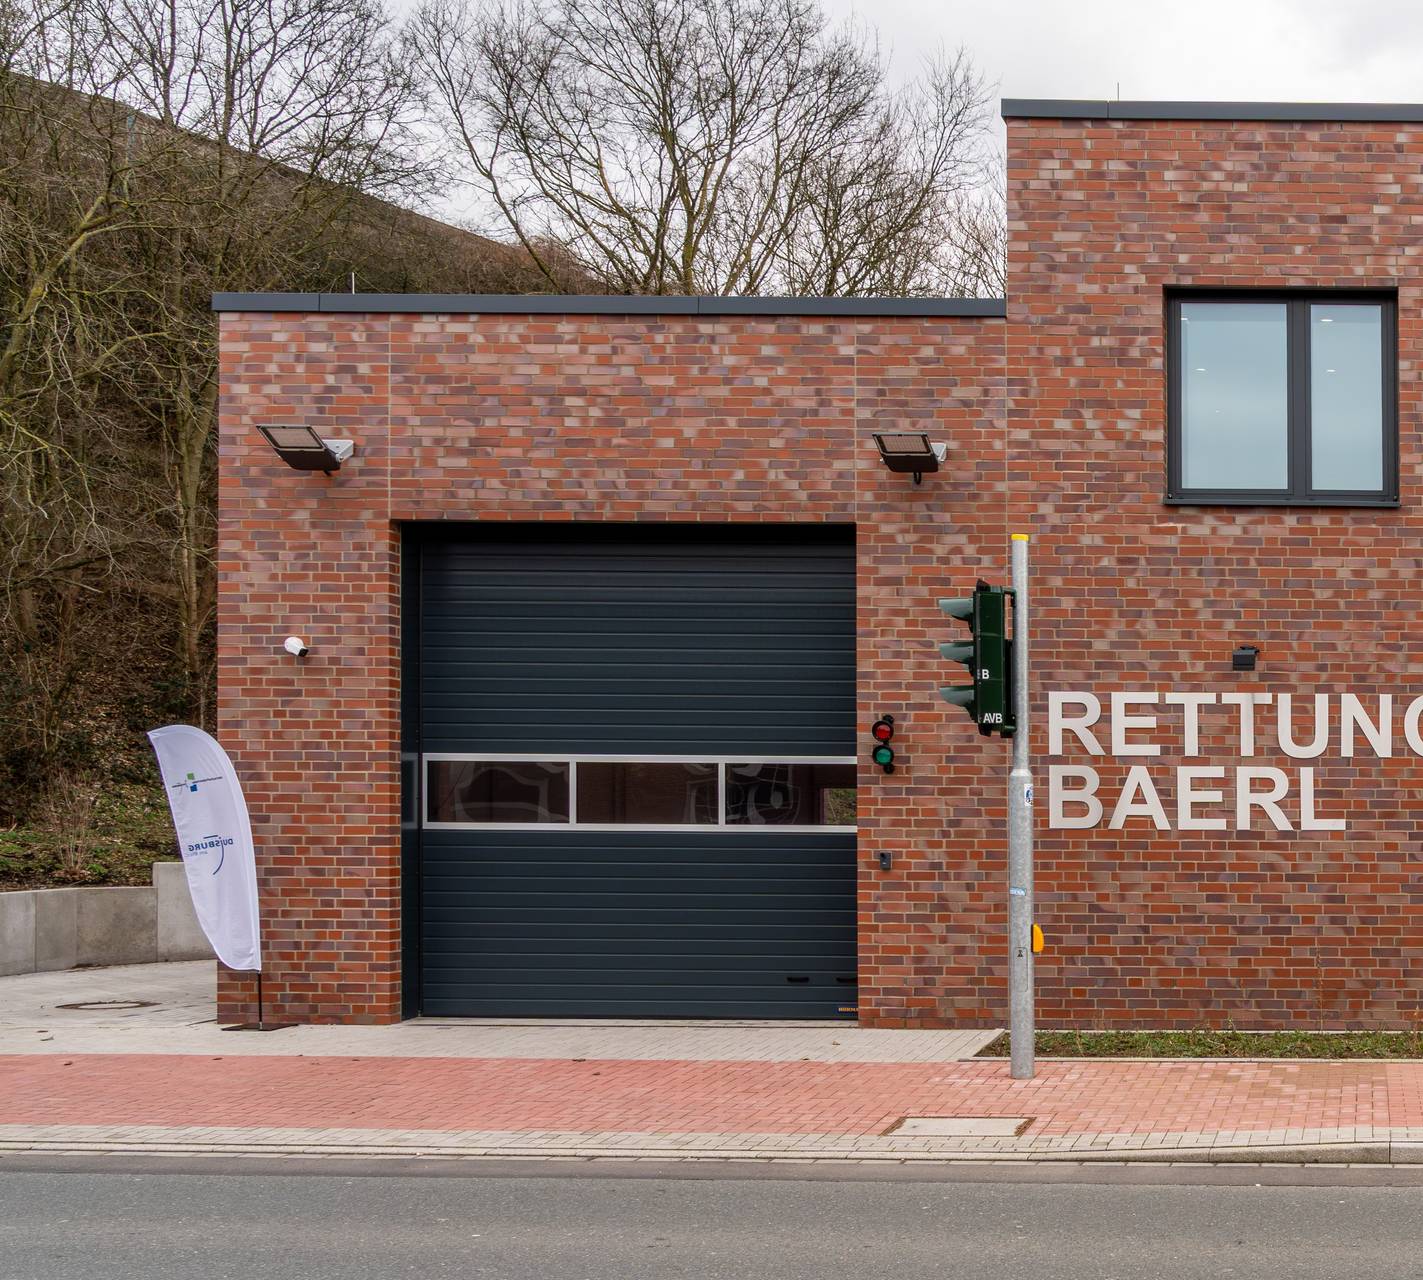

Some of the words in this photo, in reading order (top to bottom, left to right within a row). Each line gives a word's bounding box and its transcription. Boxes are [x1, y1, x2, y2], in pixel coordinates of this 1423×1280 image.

[982, 669, 990, 680] B
[983, 712, 1003, 724] AVB
[1048, 764, 1346, 831] BAERL
